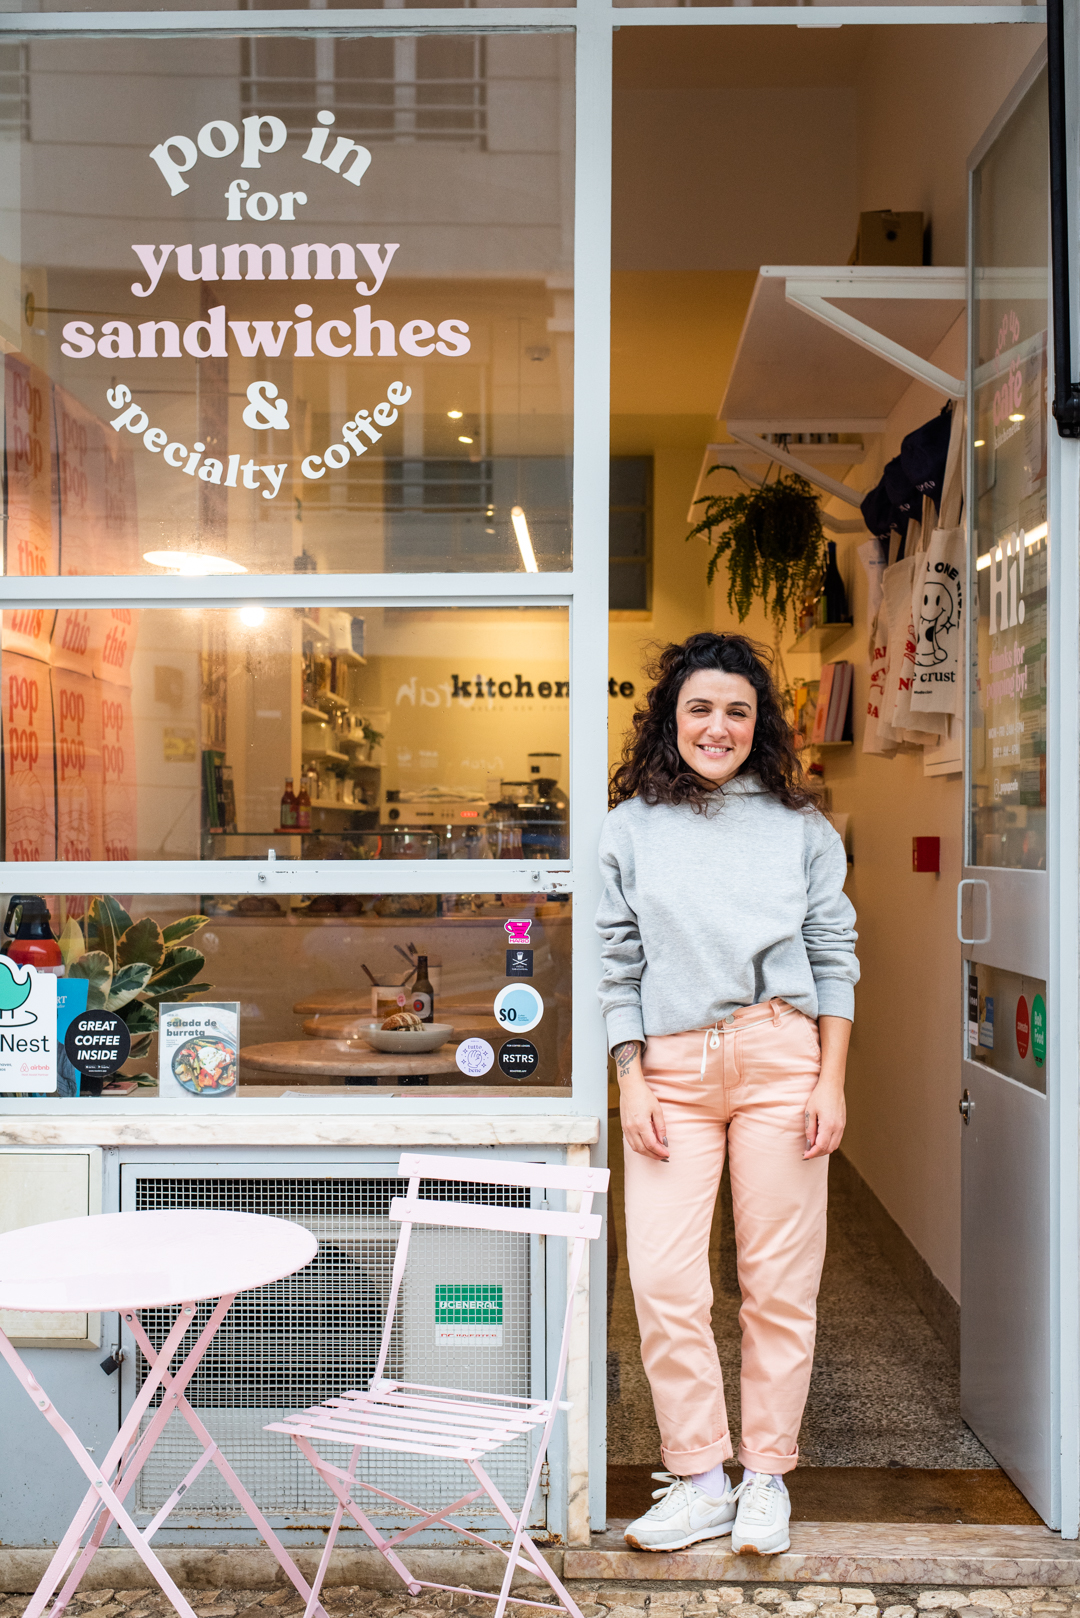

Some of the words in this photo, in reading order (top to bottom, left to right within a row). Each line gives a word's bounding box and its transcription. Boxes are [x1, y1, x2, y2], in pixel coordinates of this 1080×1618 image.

[149, 115, 288, 197] pop
[302, 110, 372, 187] in
[225, 179, 307, 221] for
[131, 243, 400, 298] yummy
[60, 303, 471, 359] sandwiches
[242, 380, 290, 430] &
[993, 355, 1022, 427] café
[106, 383, 288, 499] specialty
[300, 380, 412, 480] coffee
[934, 562, 959, 581] ONE
[988, 528, 1025, 636] Hi!
[103, 626, 127, 668] this
[988, 645, 1013, 675] thanks
[1013, 641, 1025, 667] for
[451, 674, 635, 698] kitchente
[920, 671, 956, 683] crust
[986, 670, 1015, 708] popping
[1015, 664, 1028, 699] by!
[8, 674, 38, 725] pop
[60, 688, 85, 736] pop
[102, 699, 123, 743] pop
[9, 726, 39, 775] pop
[60, 736, 85, 782] pop
[102, 743, 124, 784] pop
[78, 1021, 117, 1031] GREAT
[166, 1019, 201, 1027] salada
[204, 1019, 217, 1027] de
[1034, 1011, 1042, 1027] Bolt
[1034, 1028, 1044, 1046] Food
[0, 1034, 50, 1053] Nest
[74, 1035, 120, 1046] COFFEE
[77, 1050, 118, 1060] INSIDE
[502, 1054, 534, 1063] RSTRS
[620, 1068, 630, 1077] EAT
